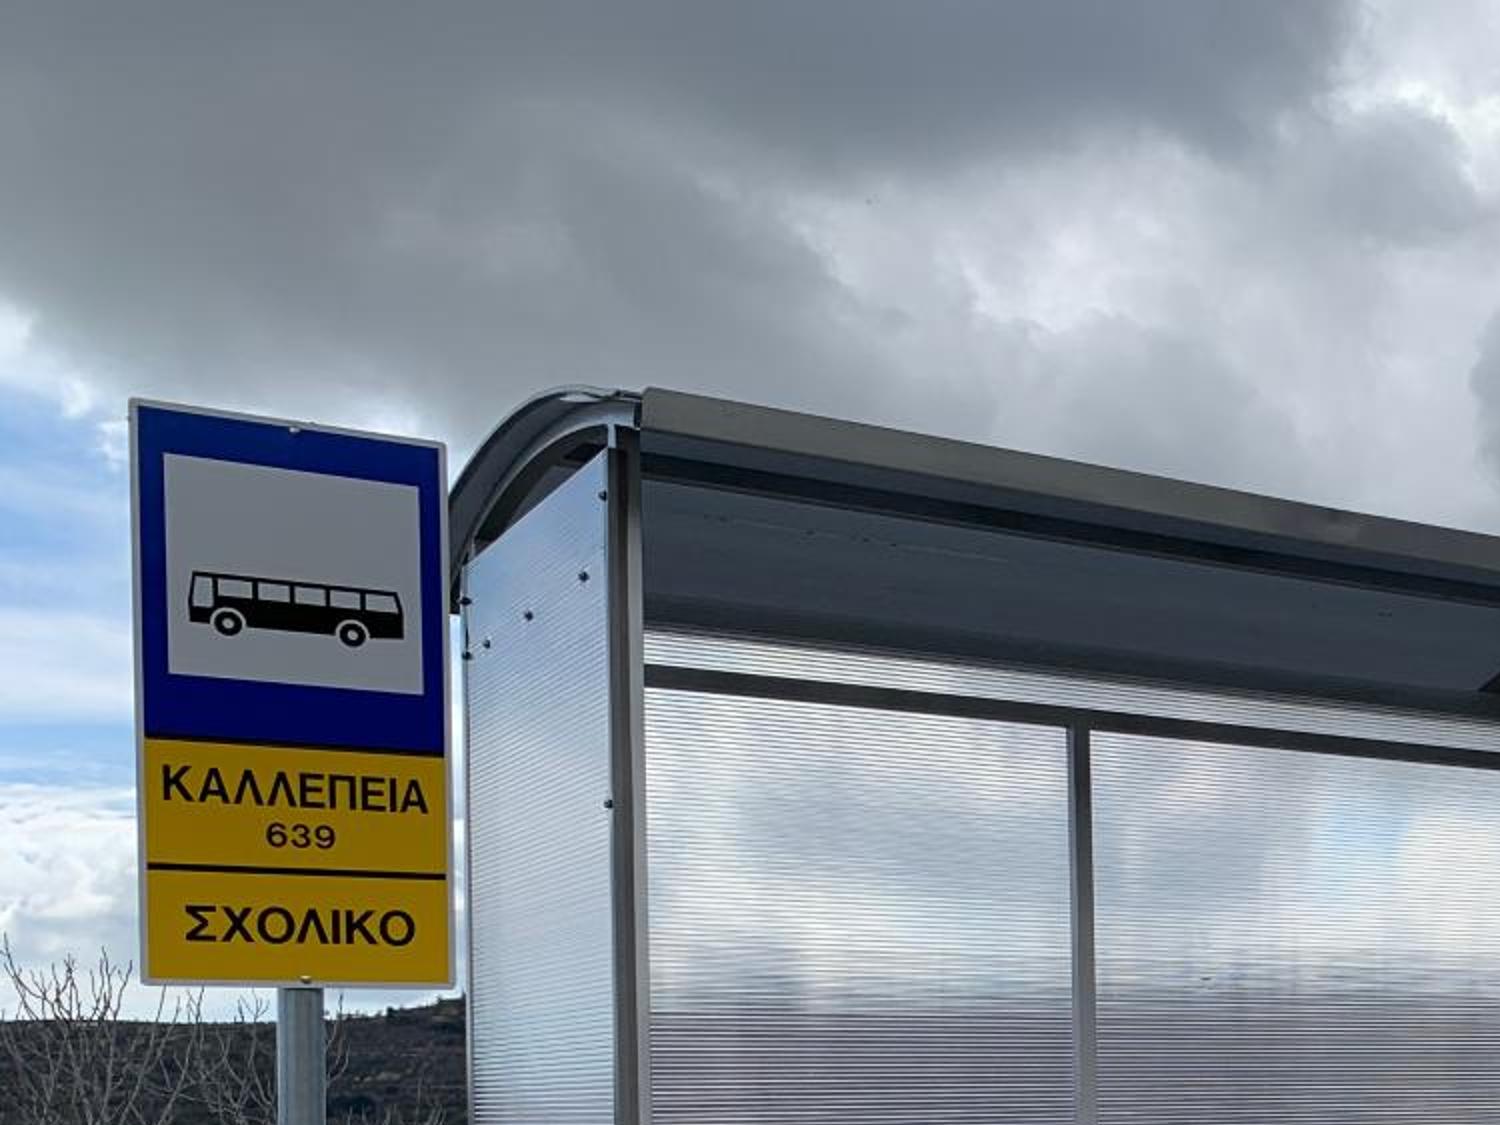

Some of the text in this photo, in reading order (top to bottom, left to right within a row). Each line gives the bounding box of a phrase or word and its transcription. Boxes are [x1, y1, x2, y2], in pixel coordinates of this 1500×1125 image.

[162, 763, 429, 815] ΚΑΛΛΕΠΕΙΑ
[265, 822, 337, 849] 639
[184, 904, 416, 947] ΣΧΟΛΙΚΟ
